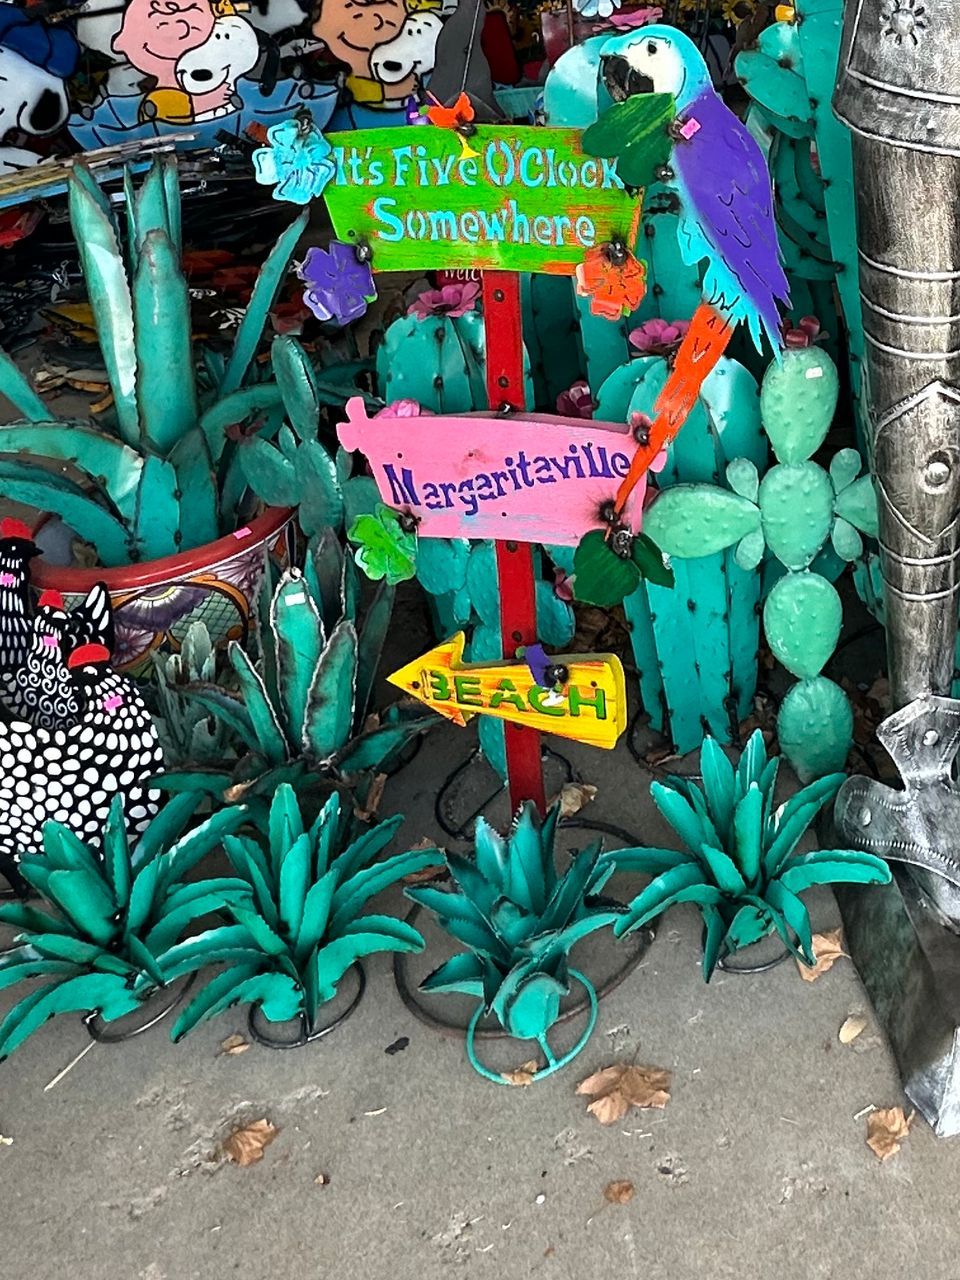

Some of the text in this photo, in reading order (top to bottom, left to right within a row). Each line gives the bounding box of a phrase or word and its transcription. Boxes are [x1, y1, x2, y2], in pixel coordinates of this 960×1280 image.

[335, 139, 625, 190] It's Five O'Clock
[373, 196, 595, 248] Somewhere
[383, 441, 632, 517] Margaritaville
[421, 669, 607, 720] BEACH
